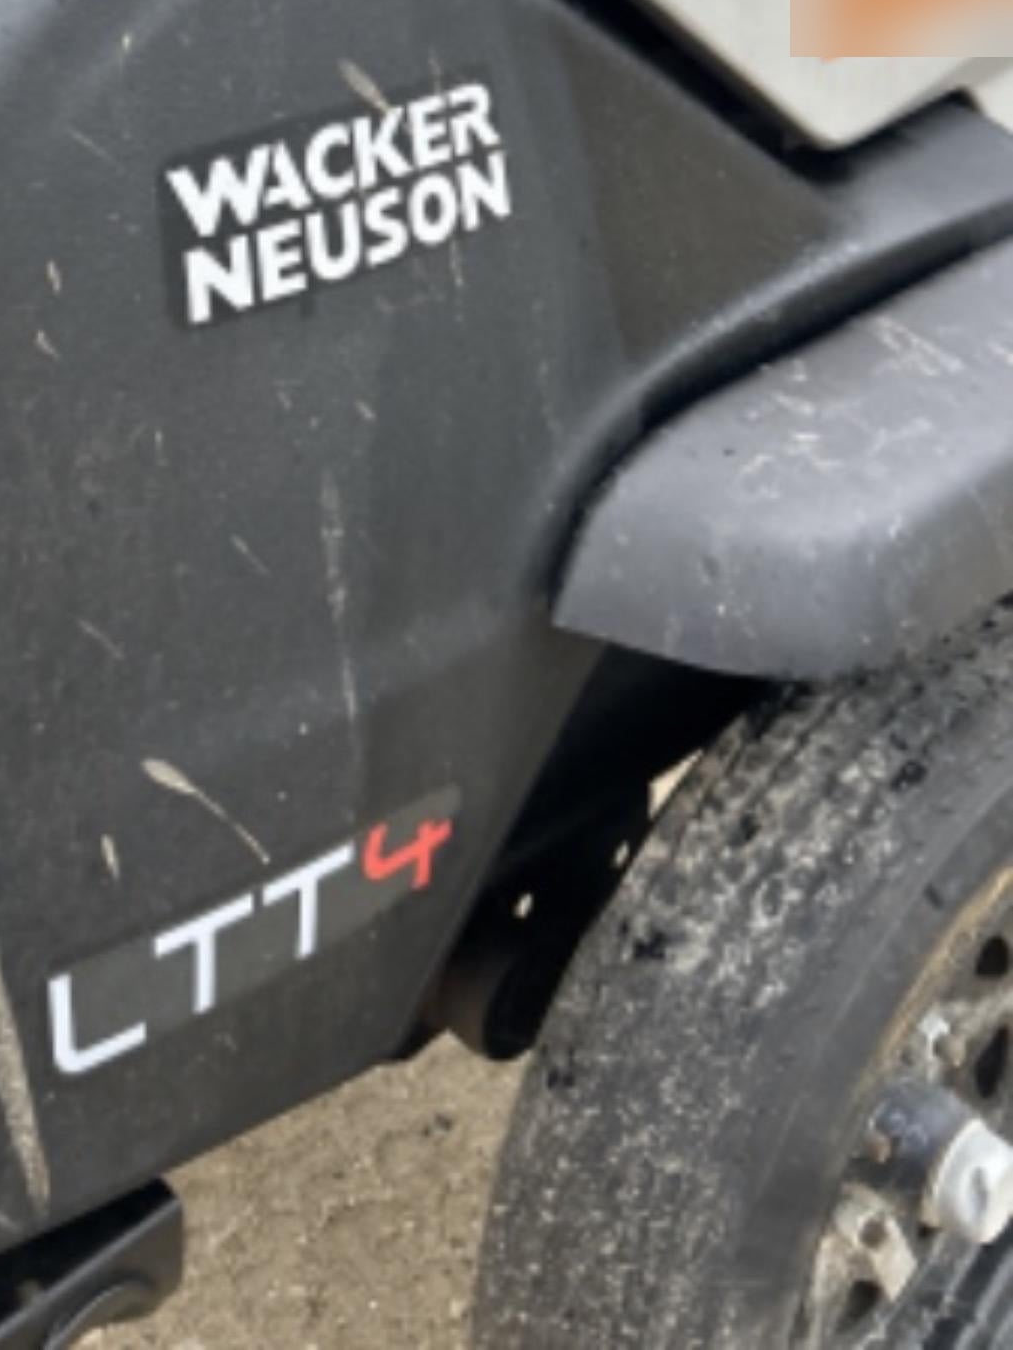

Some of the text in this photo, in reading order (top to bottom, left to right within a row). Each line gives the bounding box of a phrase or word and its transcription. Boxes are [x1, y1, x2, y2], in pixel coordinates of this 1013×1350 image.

[165, 83, 501, 237] WACKER
[184, 151, 512, 324] NEUSON
[48, 818, 454, 1074] LTT4
